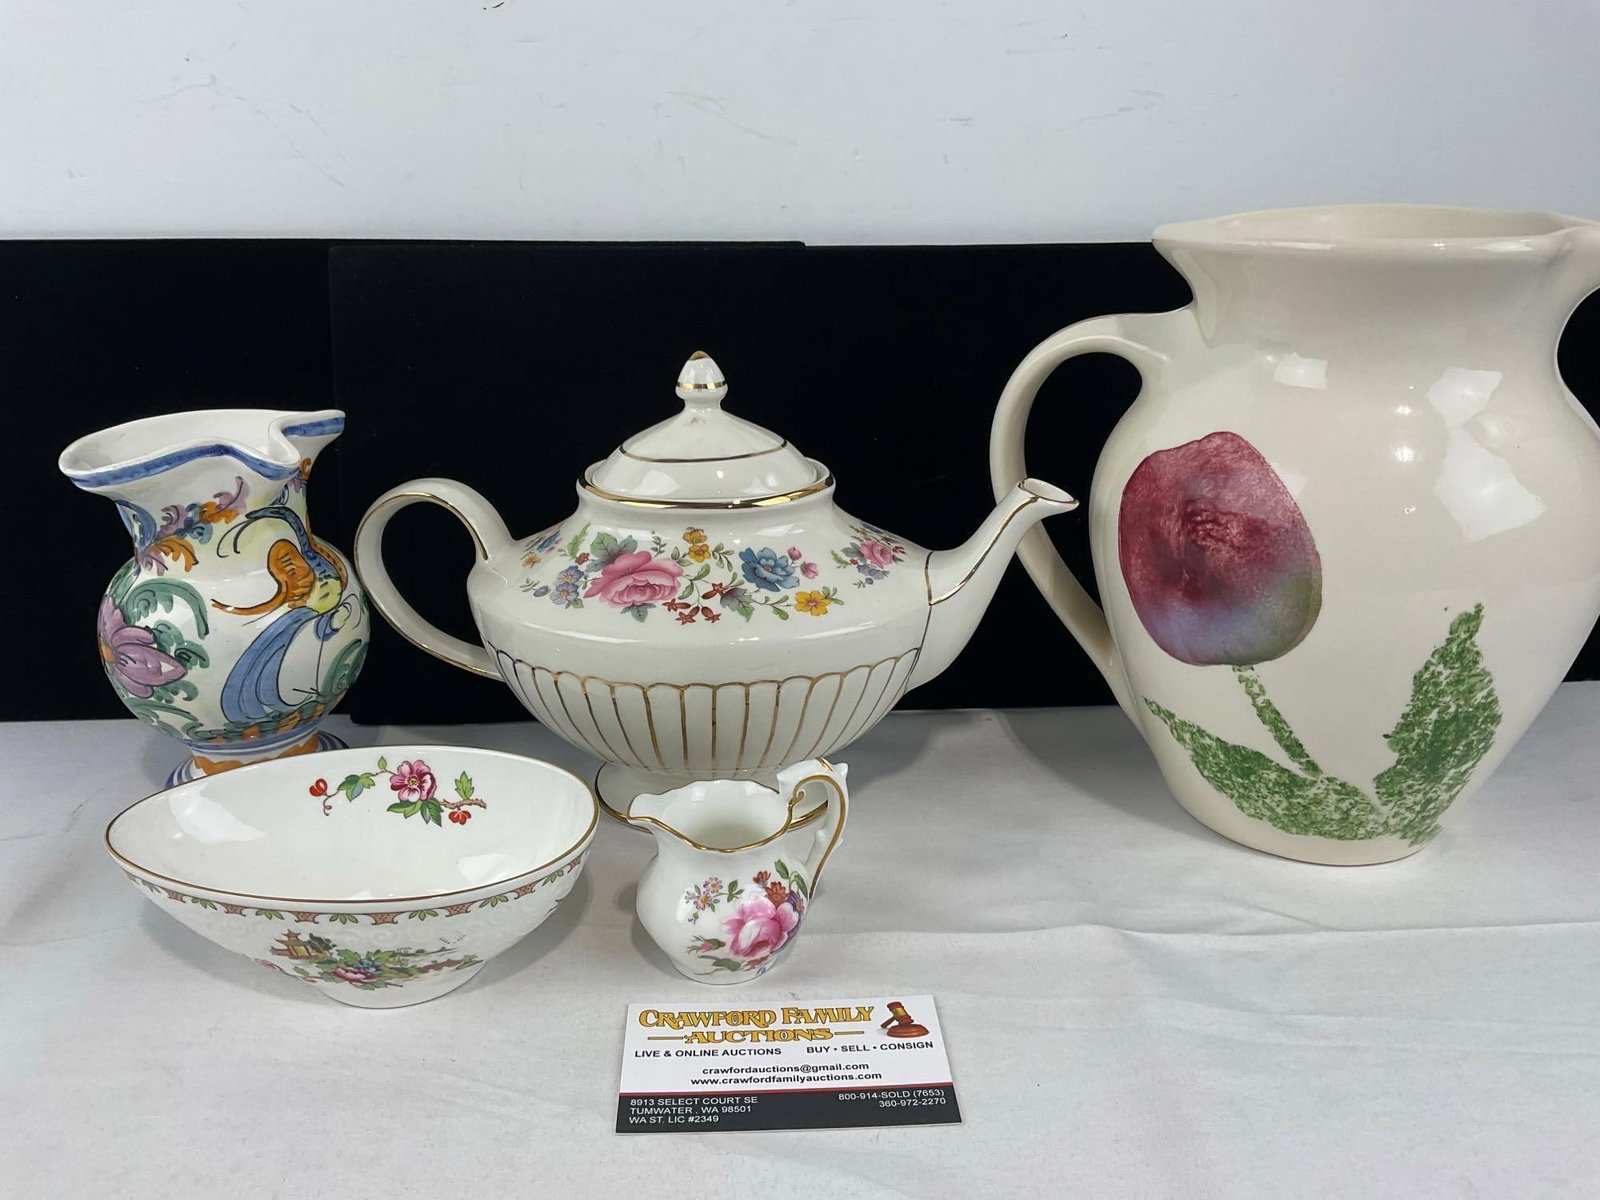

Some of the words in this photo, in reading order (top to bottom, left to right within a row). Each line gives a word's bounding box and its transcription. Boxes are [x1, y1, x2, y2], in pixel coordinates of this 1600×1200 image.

[639, 1009, 776, 1029] CRAWFORD
[781, 1006, 874, 1024] FAMILY
[684, 1028, 834, 1044] AUCTIONS
[880, 1041, 933, 1051] CONSIGN
[675, 1049, 718, 1057] ONLINE
[721, 1048, 782, 1056] AUCTIONS
[702, 1063, 869, 1075] crawfordauctions@gmail.com
[691, 1072, 882, 1085] www.crawfordfamilyauctions.com
[838, 1090, 910, 1100] 800-914-SOLD
[913, 1089, 945, 1098] (7653)
[630, 1098, 654, 1106] 8913
[658, 1098, 699, 1106] SELECT
[702, 1097, 741, 1105] COURT
[879, 1097, 946, 1107] 360-972-2270
[701, 1106, 719, 1114] WA
[721, 1105, 751, 1113] 98501
[629, 1116, 646, 1124] WA
[688, 1115, 719, 1123] #2349
